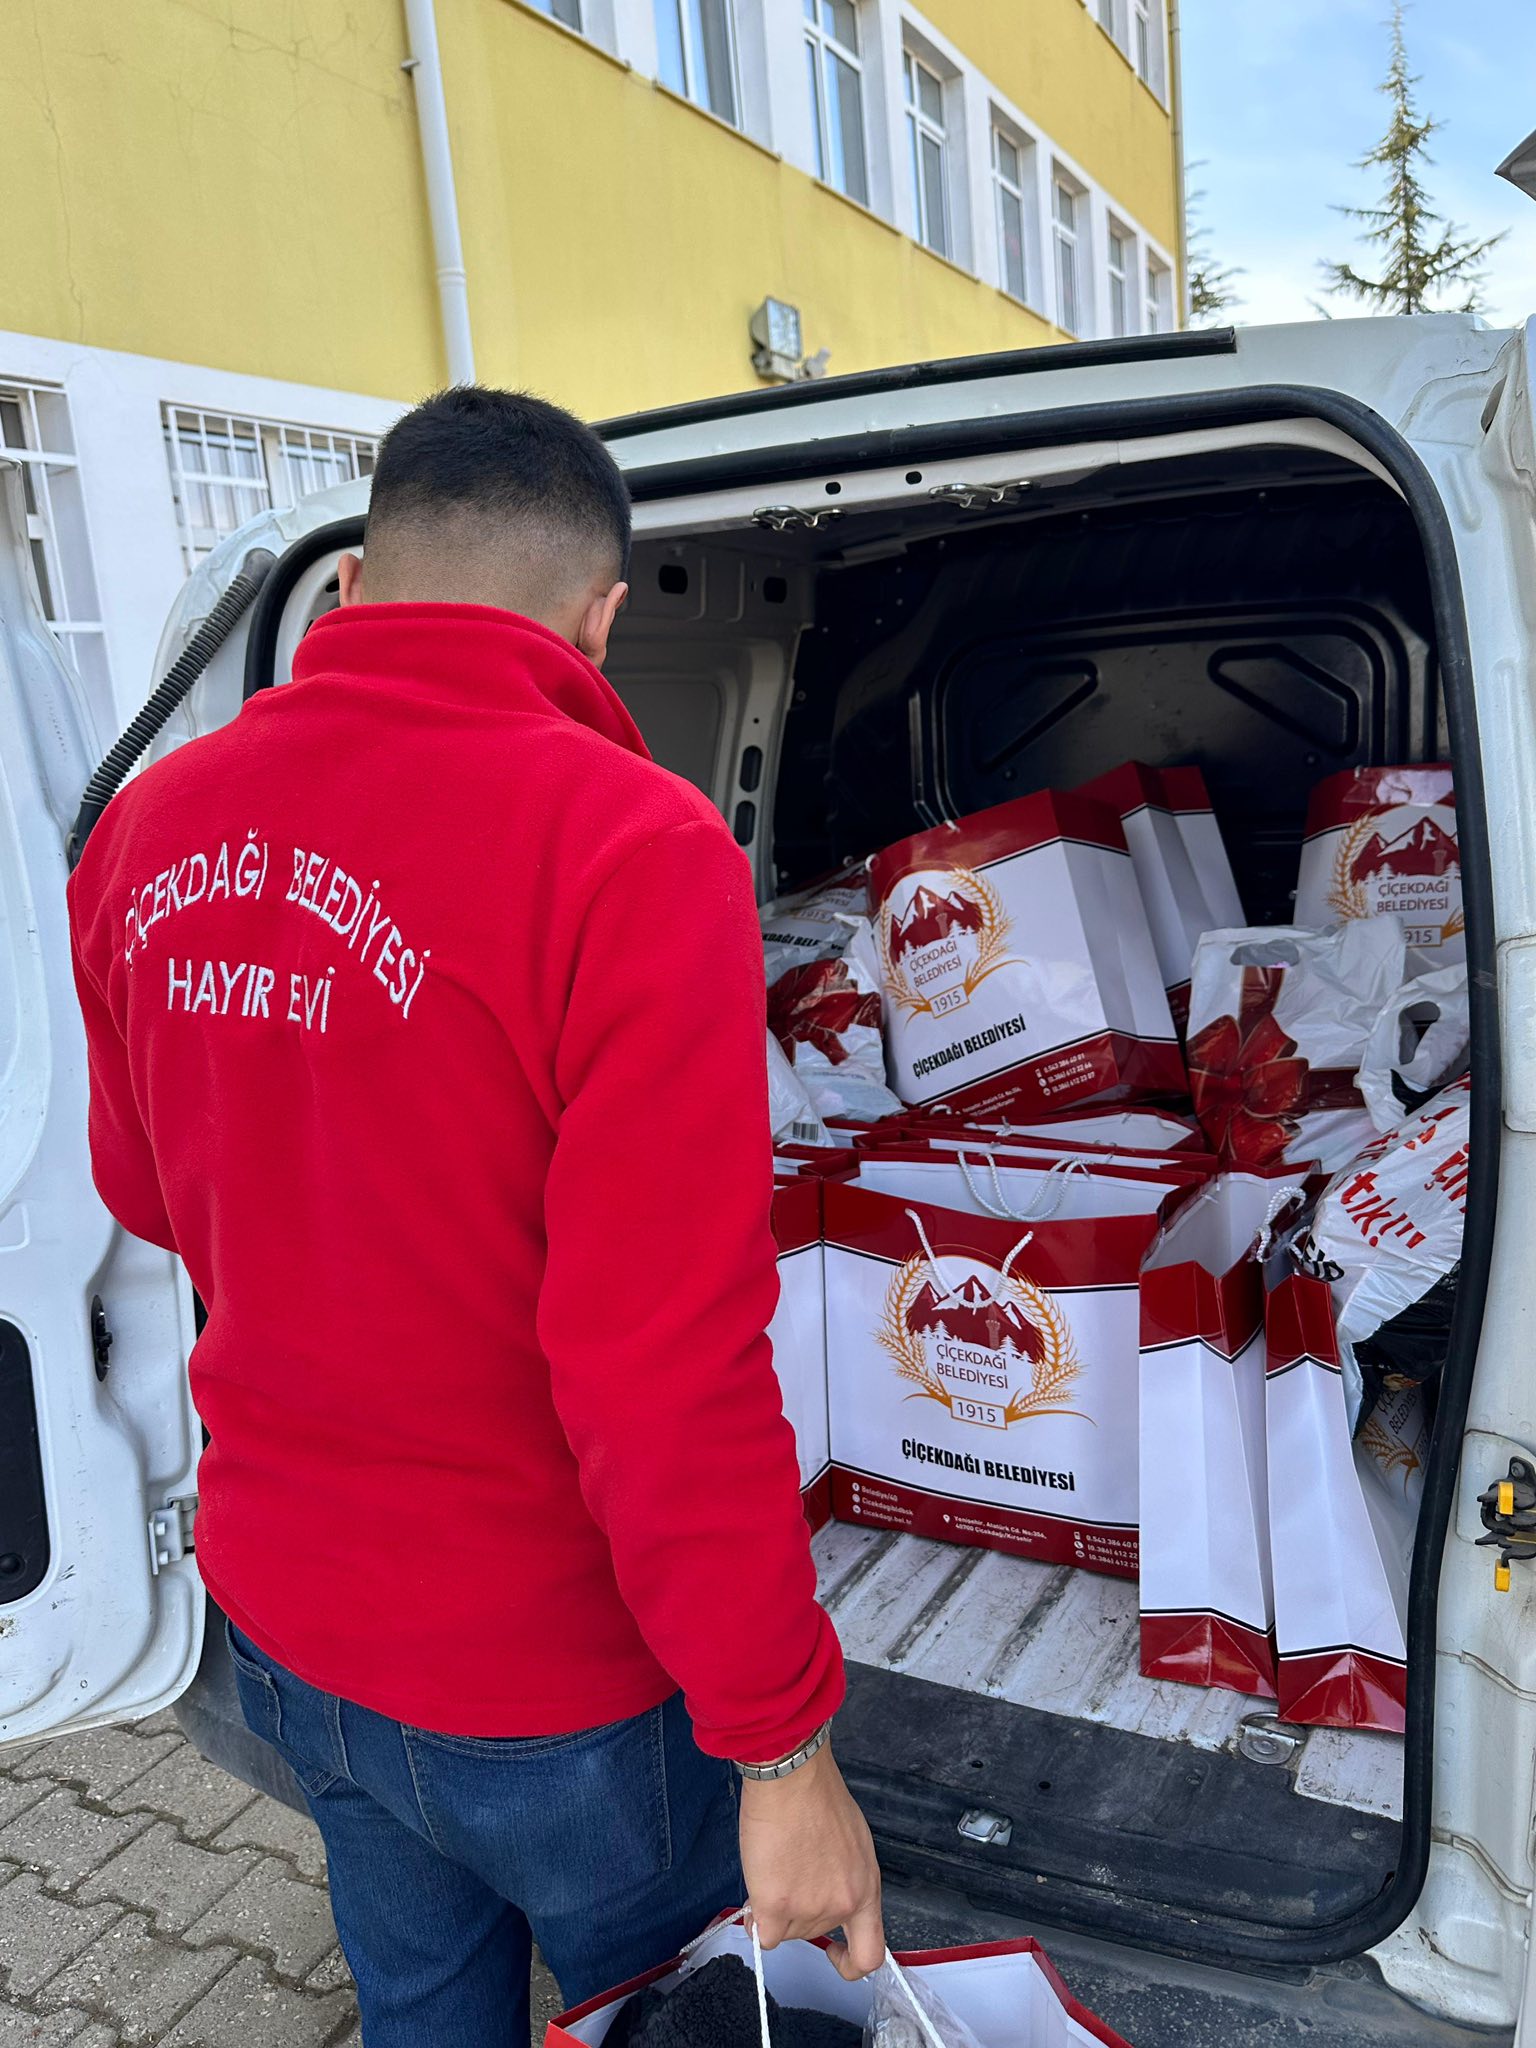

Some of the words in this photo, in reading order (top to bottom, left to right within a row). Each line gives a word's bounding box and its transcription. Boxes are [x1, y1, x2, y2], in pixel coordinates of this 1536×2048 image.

[1378, 880, 1449, 897] ÇİÇEKDAĞI
[1377, 896, 1449, 912] BELEDİYESİ
[286, 847, 431, 1019] BELEDİYESİ
[1403, 929, 1432, 943] 915
[909, 940, 957, 973] ÇİÇEKDAĞI
[914, 954, 962, 988] BELEDİYESİ
[167, 958, 275, 1019] HAYIR
[287, 966, 336, 1033] EVİ
[934, 990, 961, 1011] 1915
[912, 1041, 965, 1080] ÇİÇEKDAĞI
[963, 1012, 1027, 1054] BELEDİYESİ
[936, 1343, 1007, 1370] ÇİÇEKDAĞI
[936, 1362, 1008, 1389] BELEDİYESİ
[957, 1402, 996, 1423] 1915
[902, 1438, 981, 1474] ÇİÇEKDAĞI
[984, 1459, 1076, 1491] BELEDİYESİ
